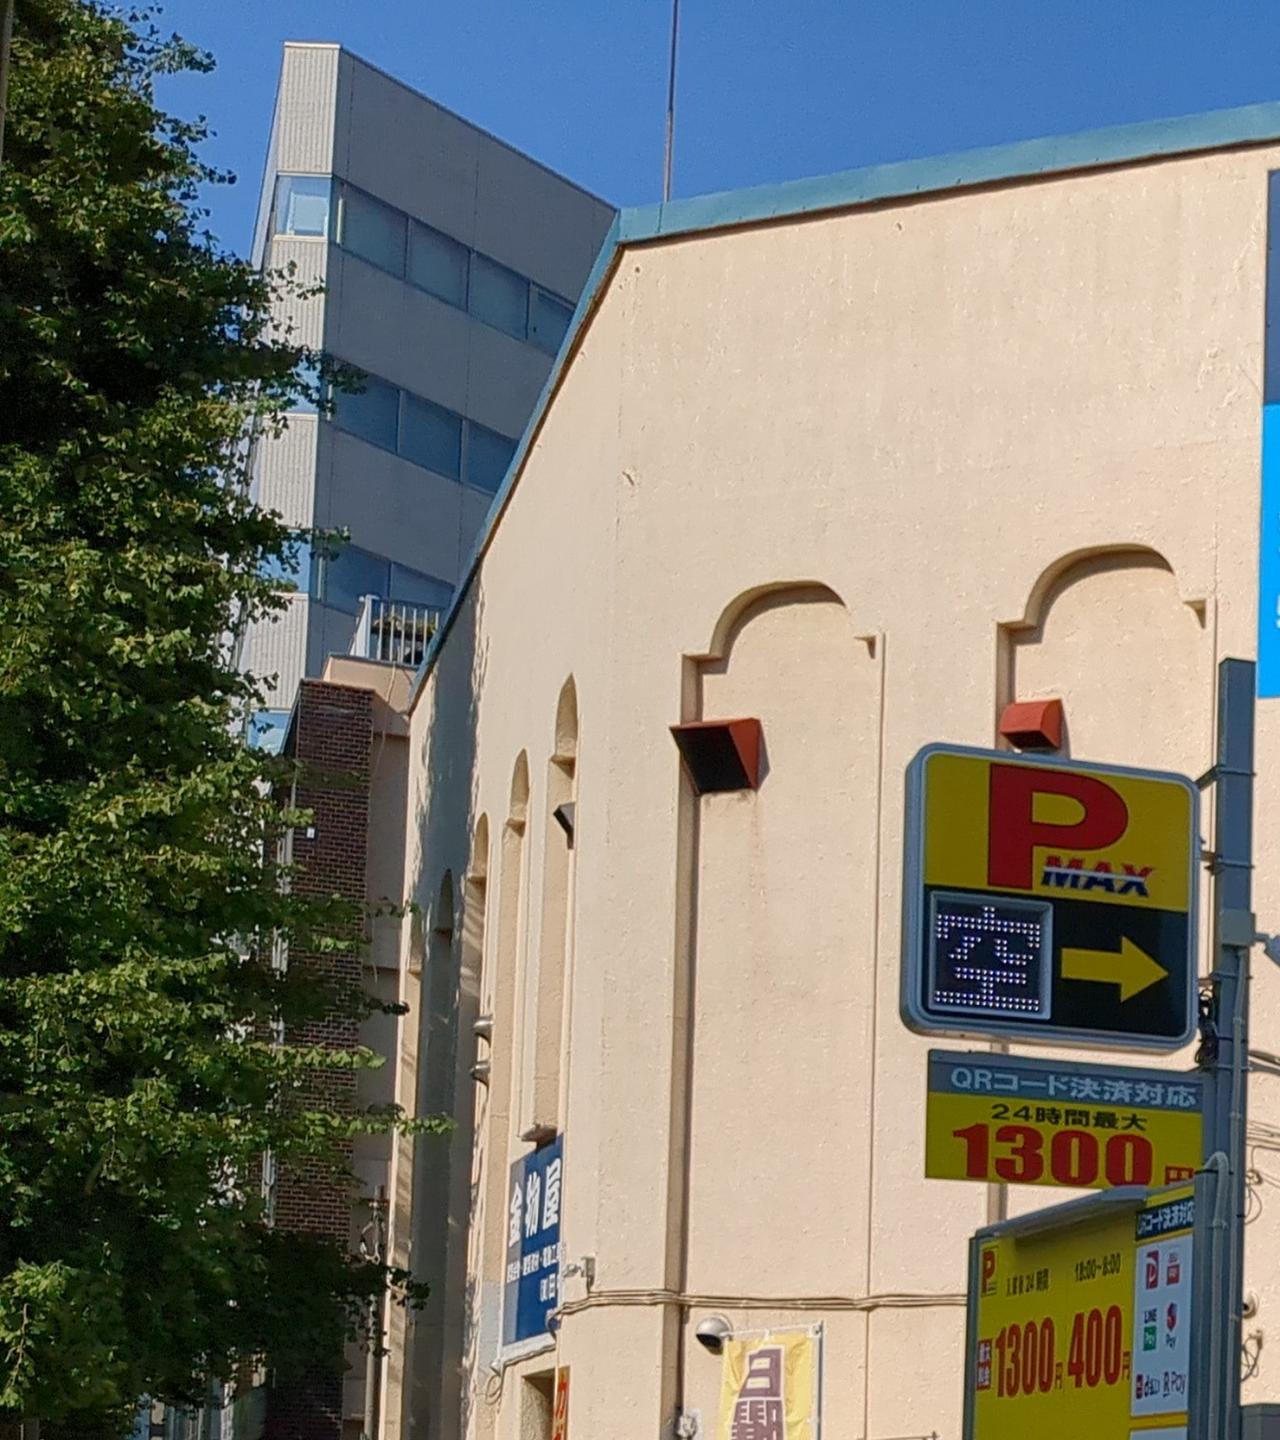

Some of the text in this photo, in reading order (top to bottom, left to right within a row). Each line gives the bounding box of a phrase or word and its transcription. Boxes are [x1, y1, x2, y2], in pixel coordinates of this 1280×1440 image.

[987, 763, 1130, 890] P
[1041, 854, 1154, 898] MAX
[934, 905, 1042, 1012] 空
[950, 1066, 1197, 1108] QRコード決済対応
[991, 1103, 1148, 1131] 24時間最大
